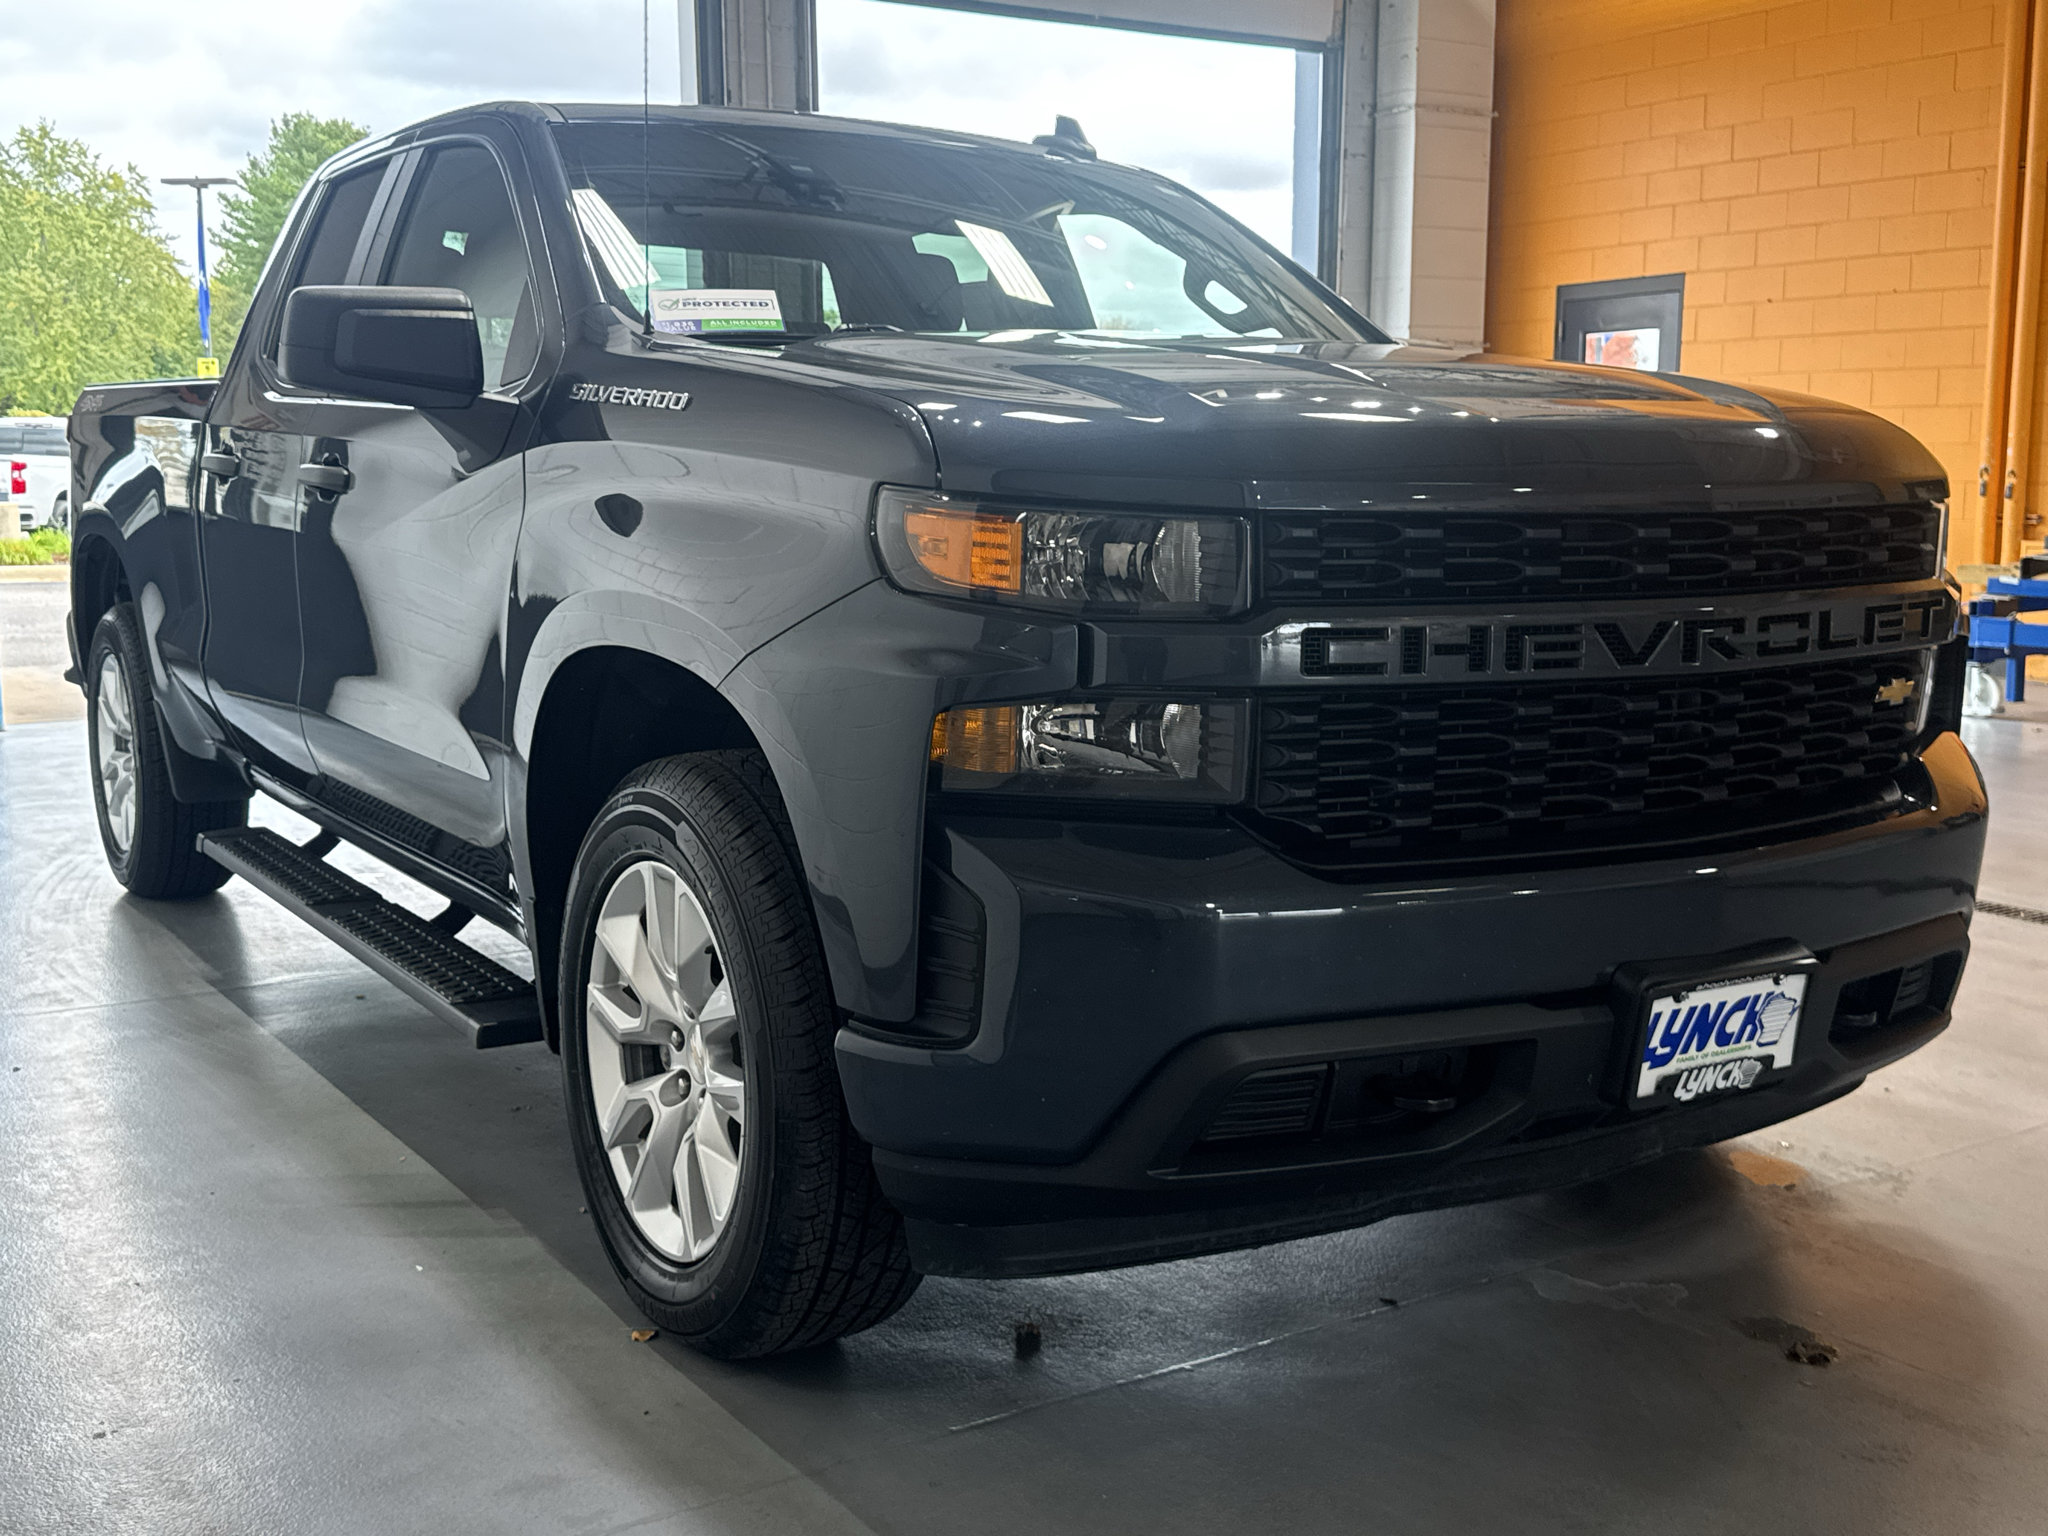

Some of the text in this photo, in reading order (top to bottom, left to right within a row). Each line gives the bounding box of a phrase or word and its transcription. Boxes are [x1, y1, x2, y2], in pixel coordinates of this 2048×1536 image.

[682, 300, 769, 308] PROTECTED
[569, 383, 689, 411] SILVERADO
[1301, 597, 1947, 678] CHEVROLET
[1643, 991, 1775, 1070] LYNCH
[1674, 1060, 1742, 1101] LYNCH
